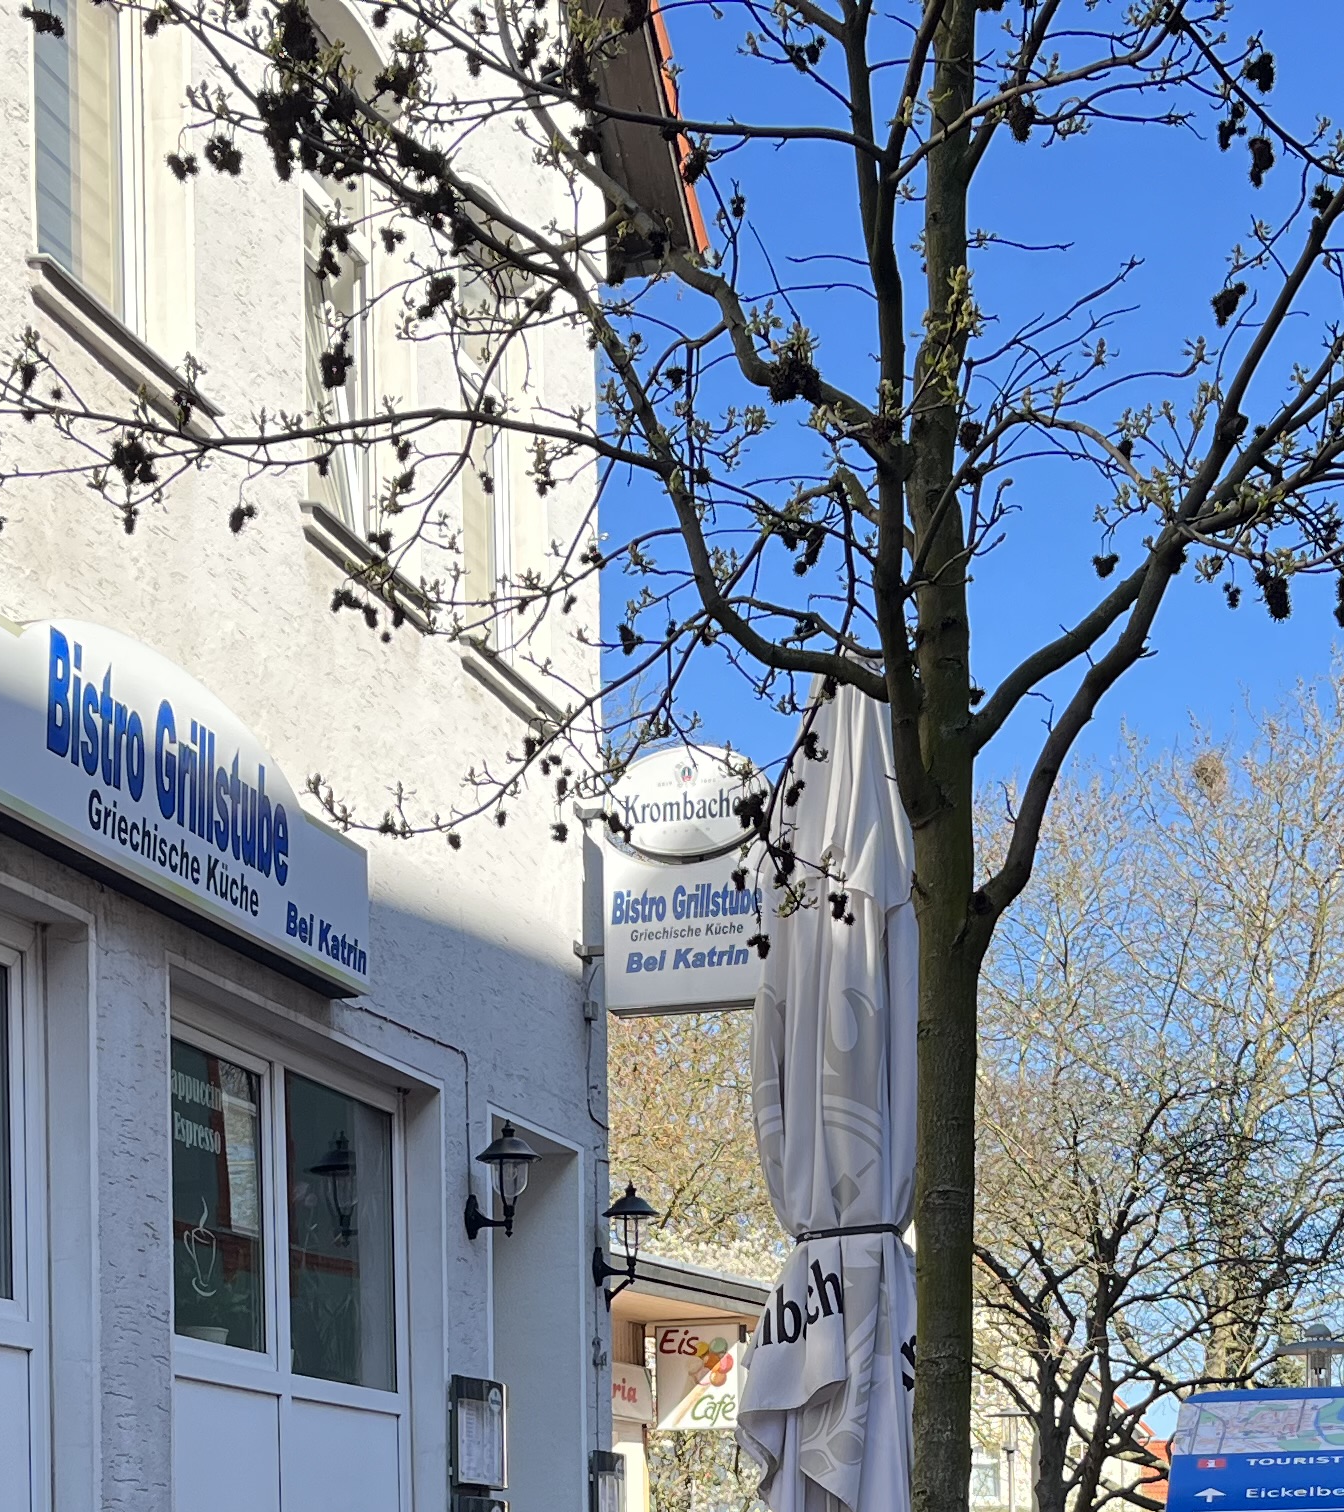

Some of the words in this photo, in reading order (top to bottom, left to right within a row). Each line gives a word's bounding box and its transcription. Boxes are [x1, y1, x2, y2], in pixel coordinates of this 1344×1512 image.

[46, 624, 145, 802] Bistro
[155, 698, 289, 887] Grillstube
[624, 788, 750, 825] Krombache
[88, 789, 201, 885] Griechische
[206, 854, 259, 917] Küche
[611, 887, 667, 926] Bistro
[672, 881, 763, 921] Grillstube
[285, 900, 314, 948] Bei
[318, 919, 368, 976] Katrin
[630, 925, 702, 942] Griechische
[705, 921, 744, 937] Küche
[672, 944, 749, 971] Katrin
[171, 1068, 223, 1113] appuccin
[173, 1110, 222, 1156] Espresso
[659, 1329, 700, 1356] Eis
[691, 1393, 736, 1427] Café
[1246, 1455, 1344, 1467] TOURIST
